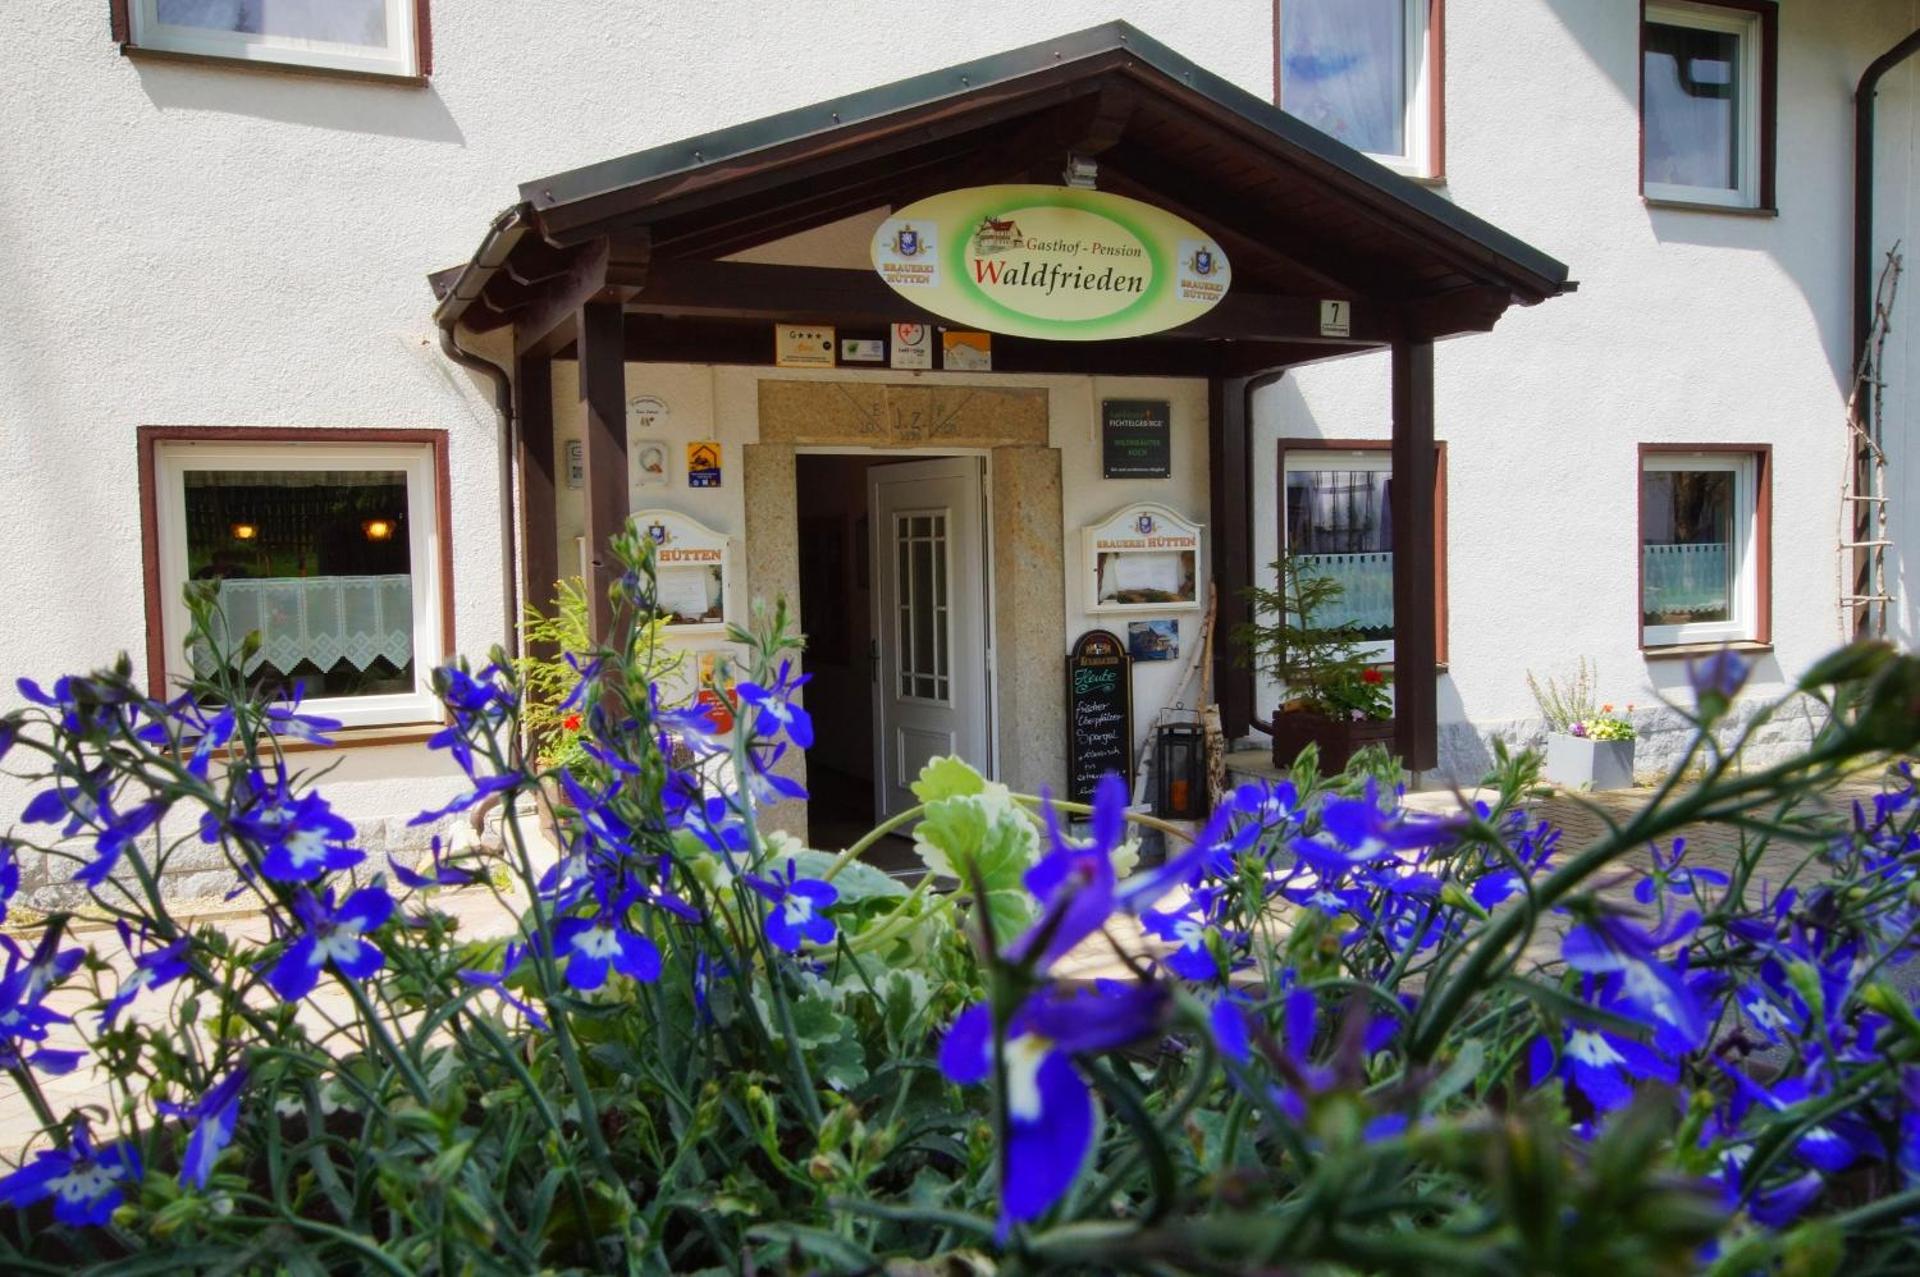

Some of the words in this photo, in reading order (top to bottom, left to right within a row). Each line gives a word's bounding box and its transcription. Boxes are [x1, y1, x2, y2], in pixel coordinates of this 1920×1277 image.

[1026, 237, 1081, 256] Gasthof
[1092, 241, 1142, 257] Pension
[883, 263, 934, 273] BRAUEREI
[974, 259, 1144, 296] Waldfrieden
[1181, 279, 1223, 292] BRAUEREI
[1331, 302, 1340, 323] 7
[1097, 539, 1145, 548] BRAUEREI
[1148, 535, 1197, 547] HÜTTEN
[660, 547, 721, 561] HÜTTEN
[1075, 668, 1118, 686] Heute
